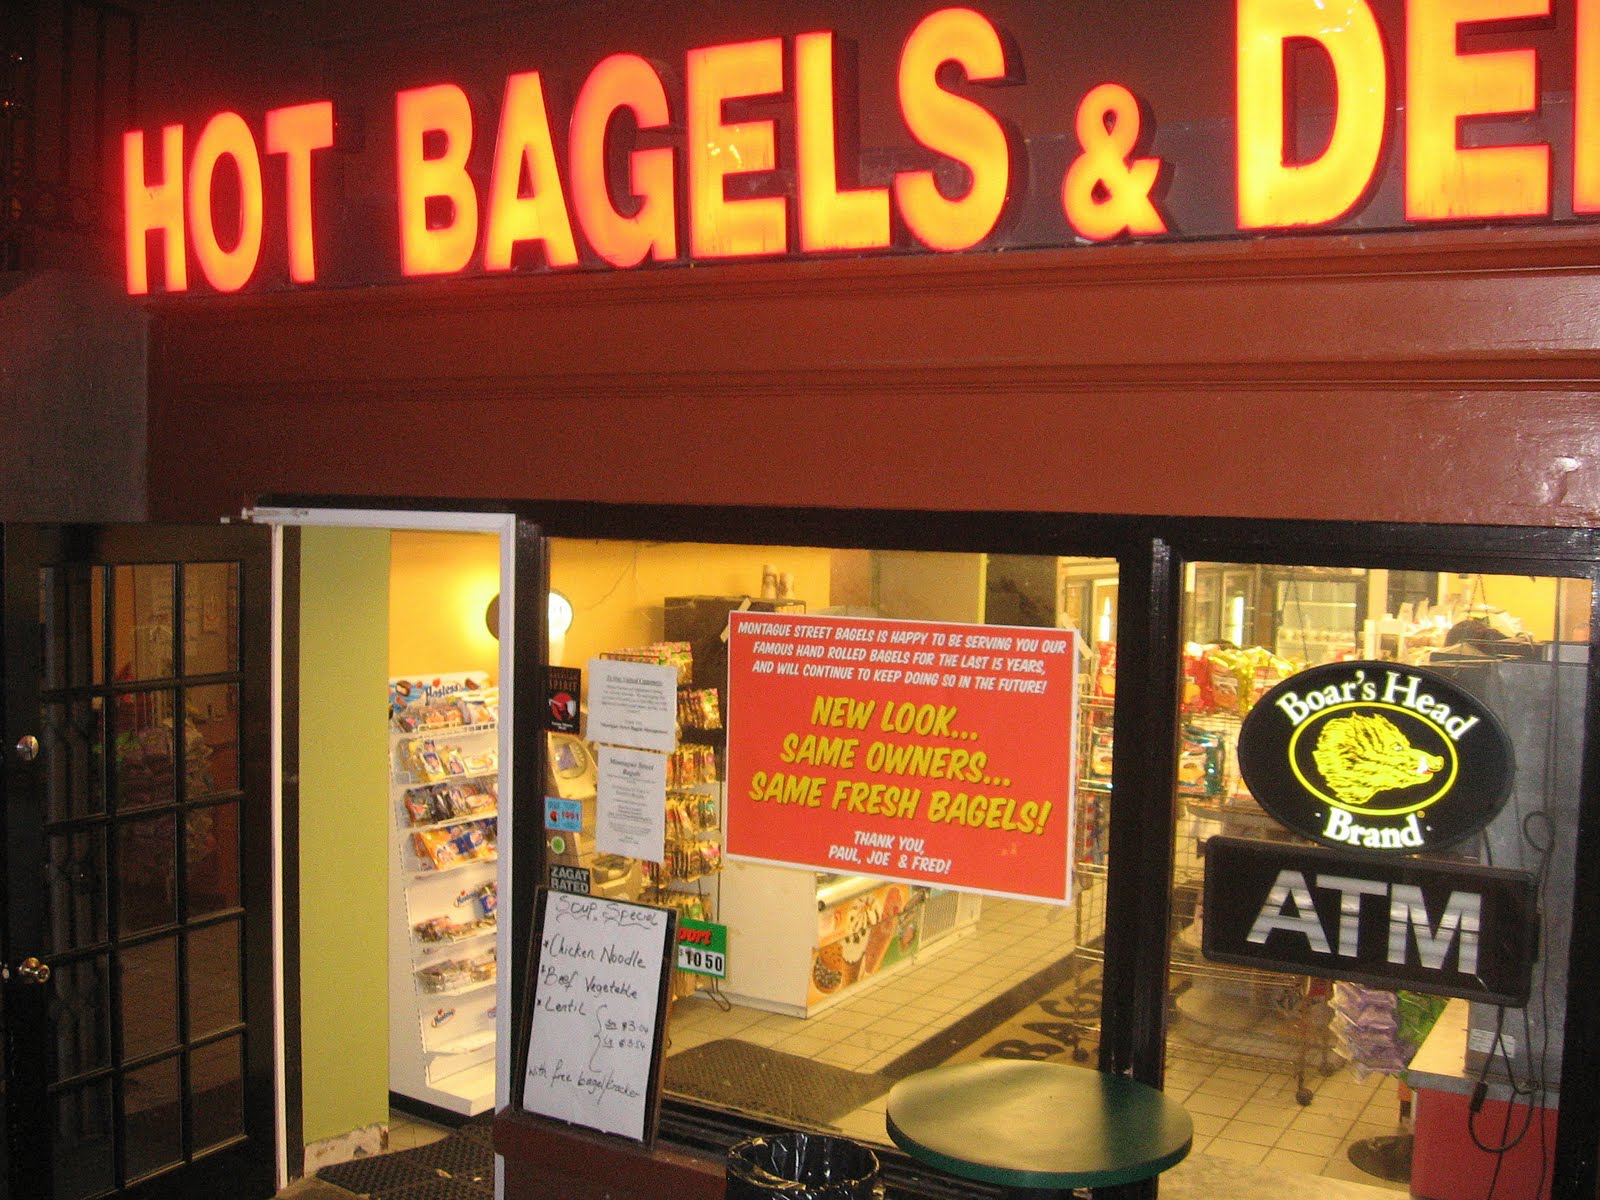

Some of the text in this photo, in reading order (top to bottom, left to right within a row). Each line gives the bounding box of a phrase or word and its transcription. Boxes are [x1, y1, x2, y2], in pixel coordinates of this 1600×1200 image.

[122, 101, 334, 294] HOT
[396, 6, 1009, 276] BAGELS
[1062, 83, 1168, 240] &
[738, 622, 1067, 654] MONTAGUE STREET BAGELS IS HAPPY TO BE SERVING YOU OUR
[752, 641, 1046, 675] FAMOUS HAND ROLLED BAGELS FOR THE LAST 15 YEARS,
[752, 660, 1048, 694] AND WILL CONTINUE TO KEEP DOING SO IN THE FUTURE!
[810, 695, 979, 741] NEW LOOK...
[1275, 670, 1479, 741] Boar's Head
[780, 732, 1012, 787] SAME OWNERS...
[749, 771, 1053, 836] SAME FRESH BAGELS!
[854, 831, 925, 855] THANK YOU,
[1322, 806, 1425, 849] Brand
[551, 867, 589, 882] ZAGAT
[828, 845, 952, 875] PAUL, JOE & FRED!
[551, 879, 589, 894] RATED
[602, 903, 658, 926] Special
[1246, 869, 1483, 976] ATM
[550, 933, 646, 969] Chicken Noodle
[544, 966, 638, 998] Beef Vegetable
[545, 998, 586, 1017] Lentil
[550, 1059, 573, 1087] free
